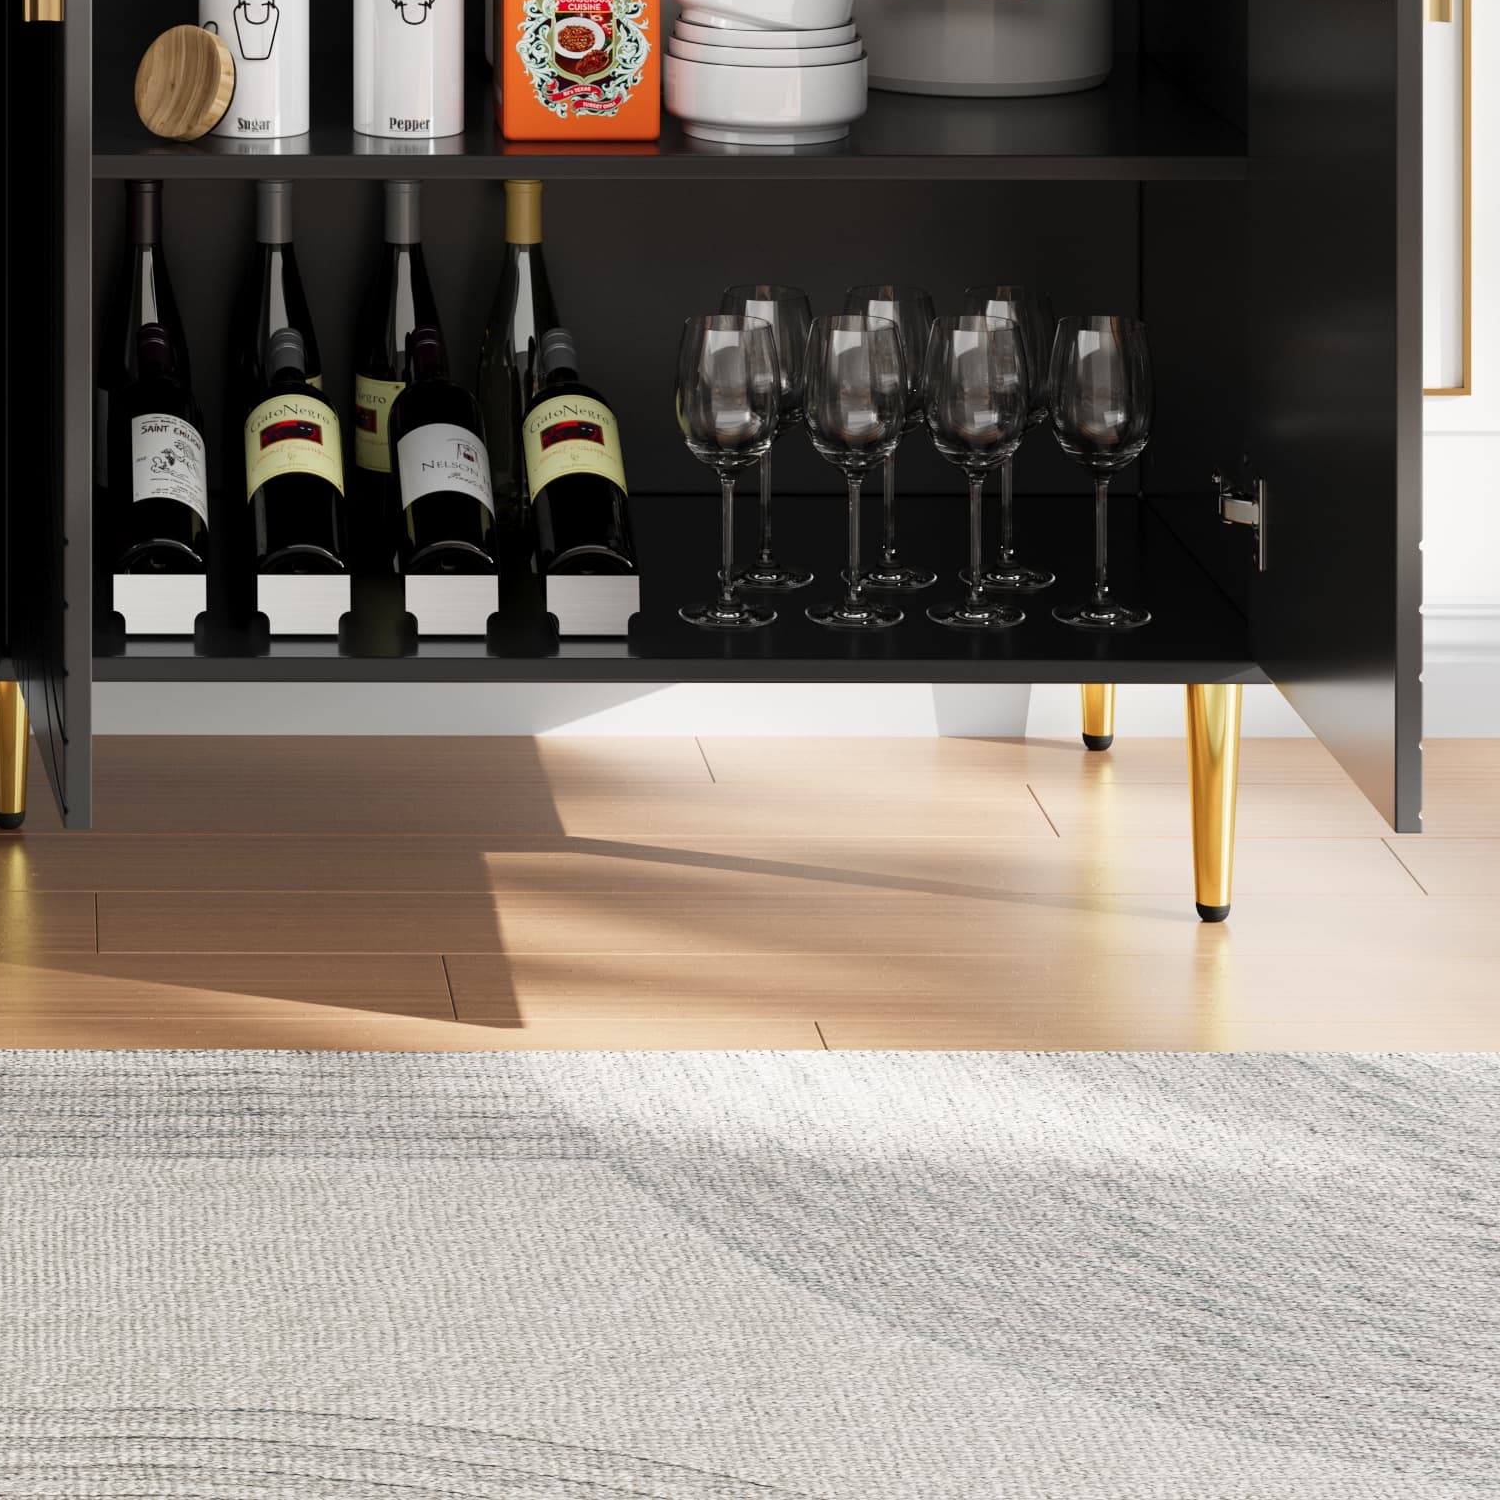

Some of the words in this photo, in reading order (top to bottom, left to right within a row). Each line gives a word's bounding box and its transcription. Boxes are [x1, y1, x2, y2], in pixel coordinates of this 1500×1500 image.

[567, 3, 602, 11] CUISINE
[237, 117, 271, 132] Sugar
[389, 117, 430, 132] Pepper
[421, 460, 479, 477] NELSON
